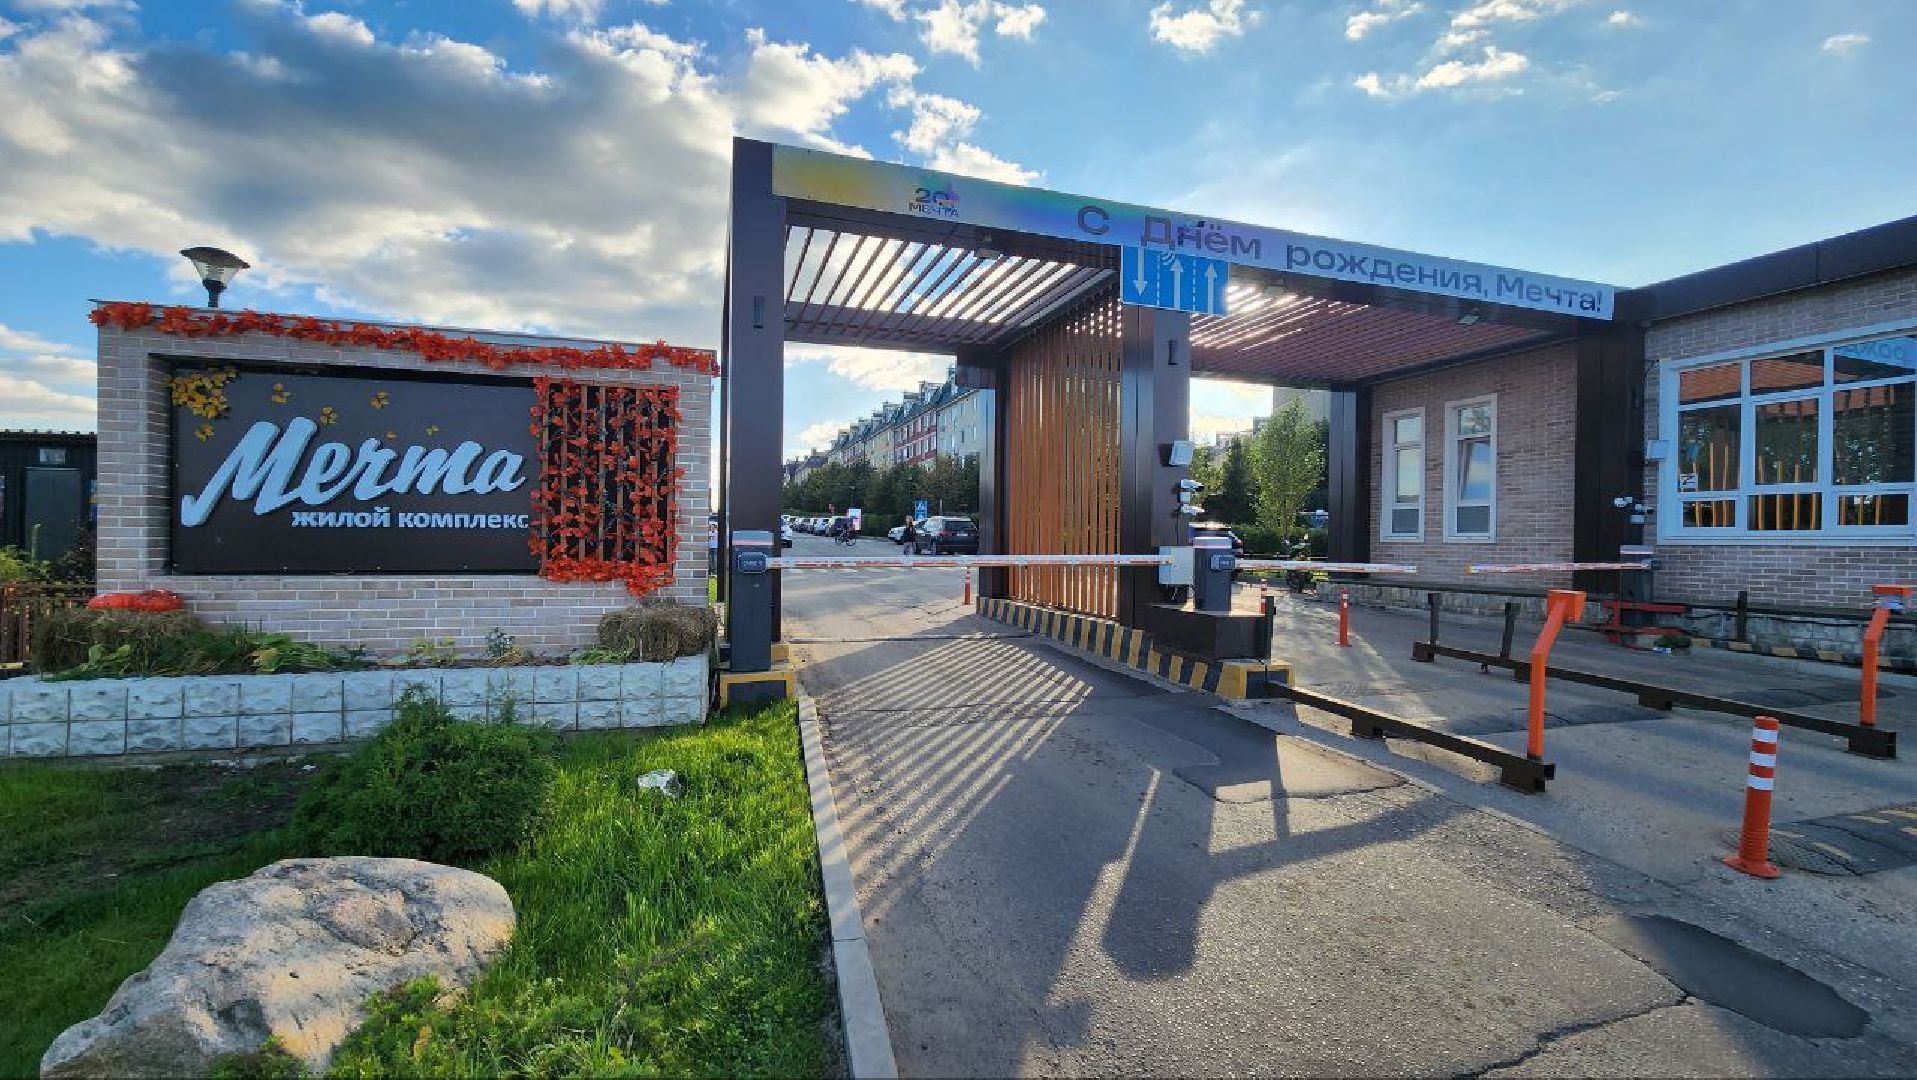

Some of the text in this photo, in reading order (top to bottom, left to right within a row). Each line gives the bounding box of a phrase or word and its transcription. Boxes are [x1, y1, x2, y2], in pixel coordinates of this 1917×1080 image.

[908, 202, 959, 217] МЕЧТА
[1078, 205, 1603, 312] С Днём рождения, Мечта!
[181, 416, 526, 527] Мечта
[291, 506, 529, 529] жилой комплекс
